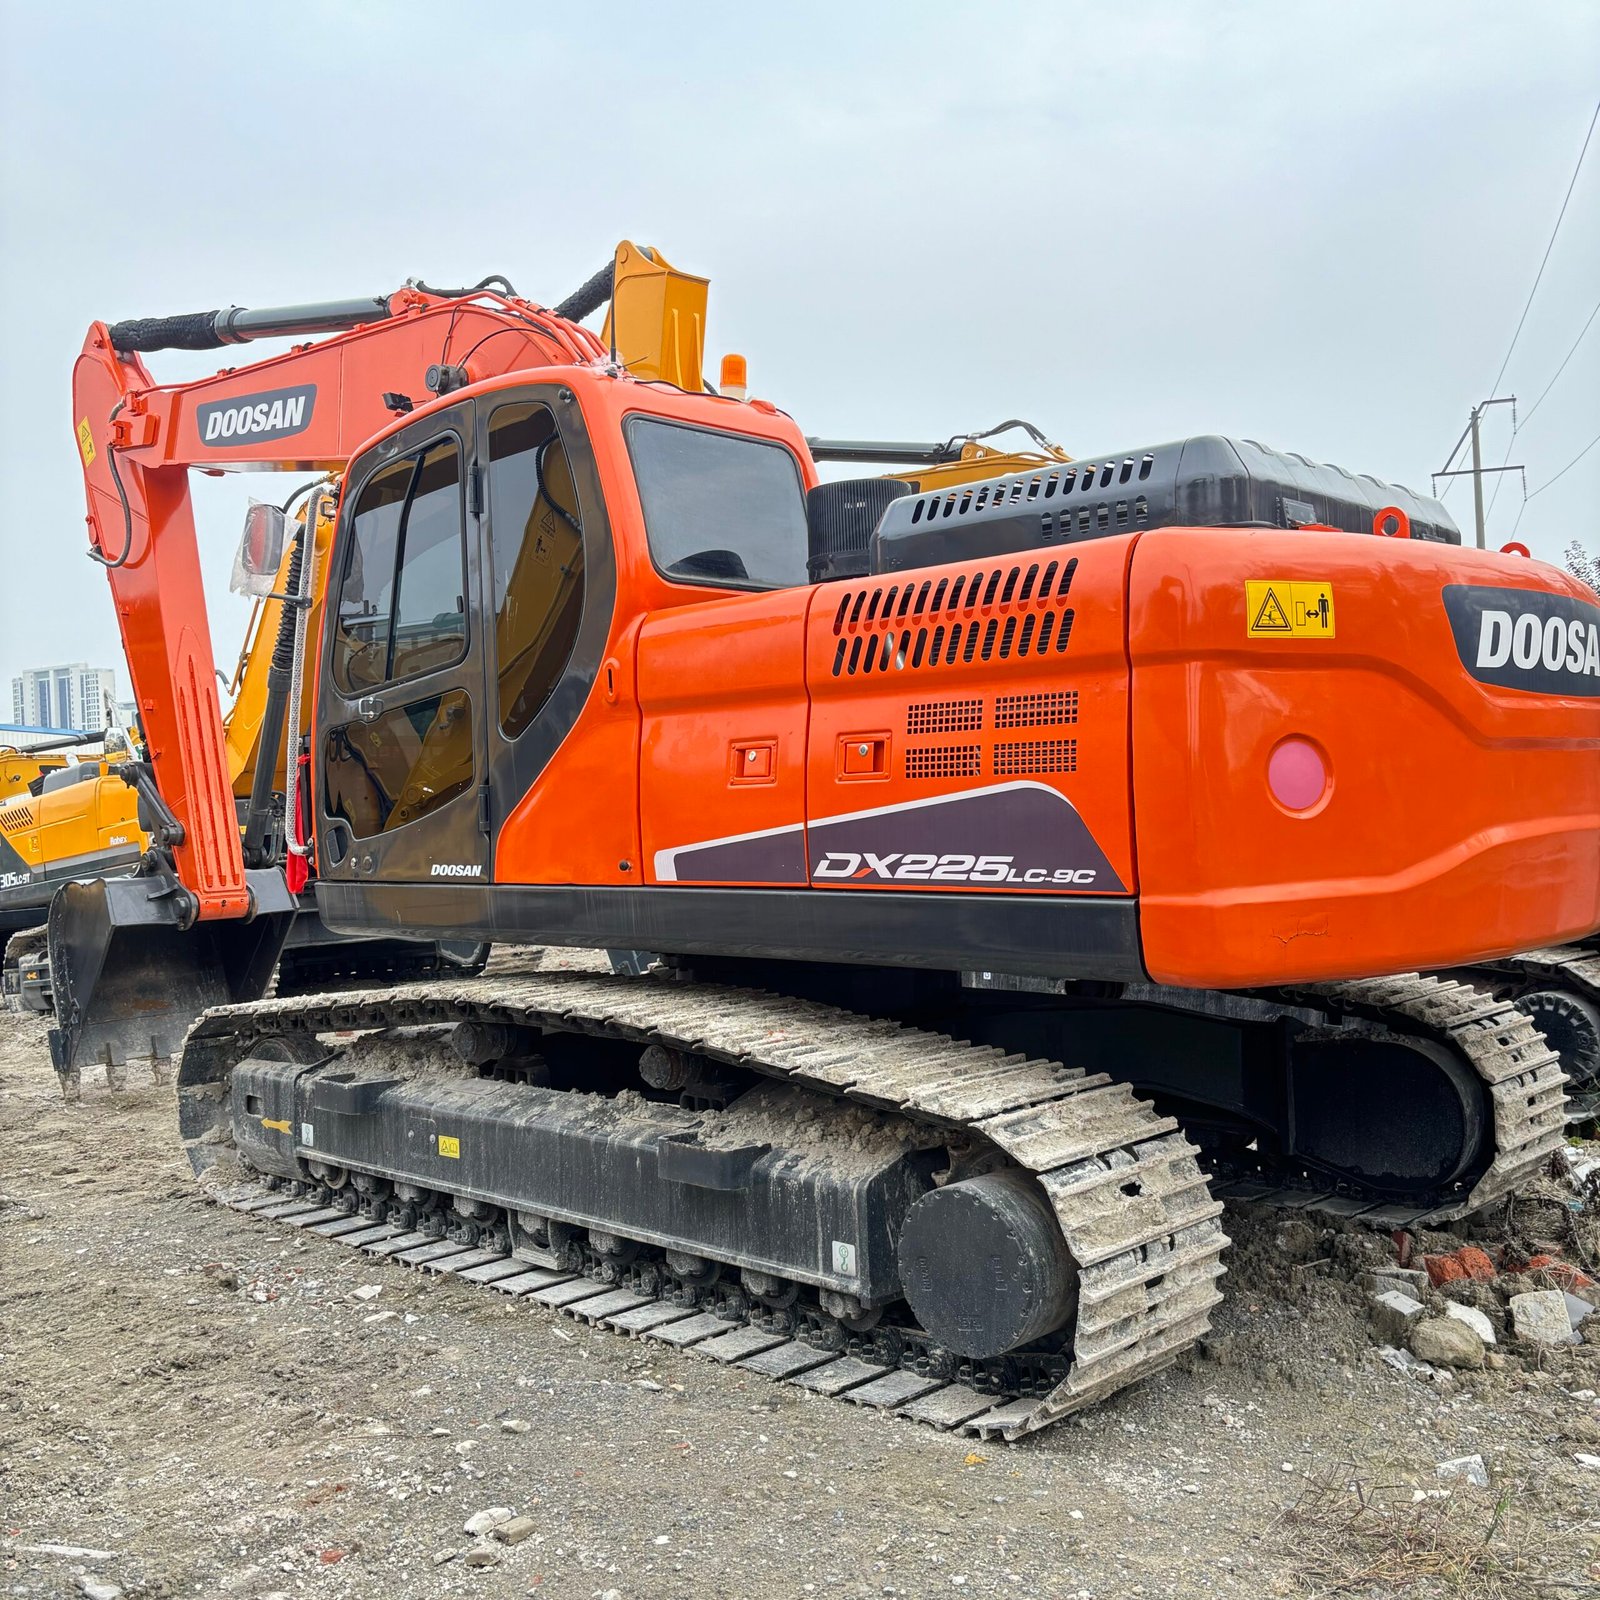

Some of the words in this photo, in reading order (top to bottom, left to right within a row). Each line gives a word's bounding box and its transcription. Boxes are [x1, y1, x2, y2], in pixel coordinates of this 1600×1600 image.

[205, 396, 305, 440] DOOSAN
[1476, 610, 1600, 677] DOOSA
[431, 864, 482, 876] DOOSAN
[813, 852, 1096, 884] DX225LC-9C
